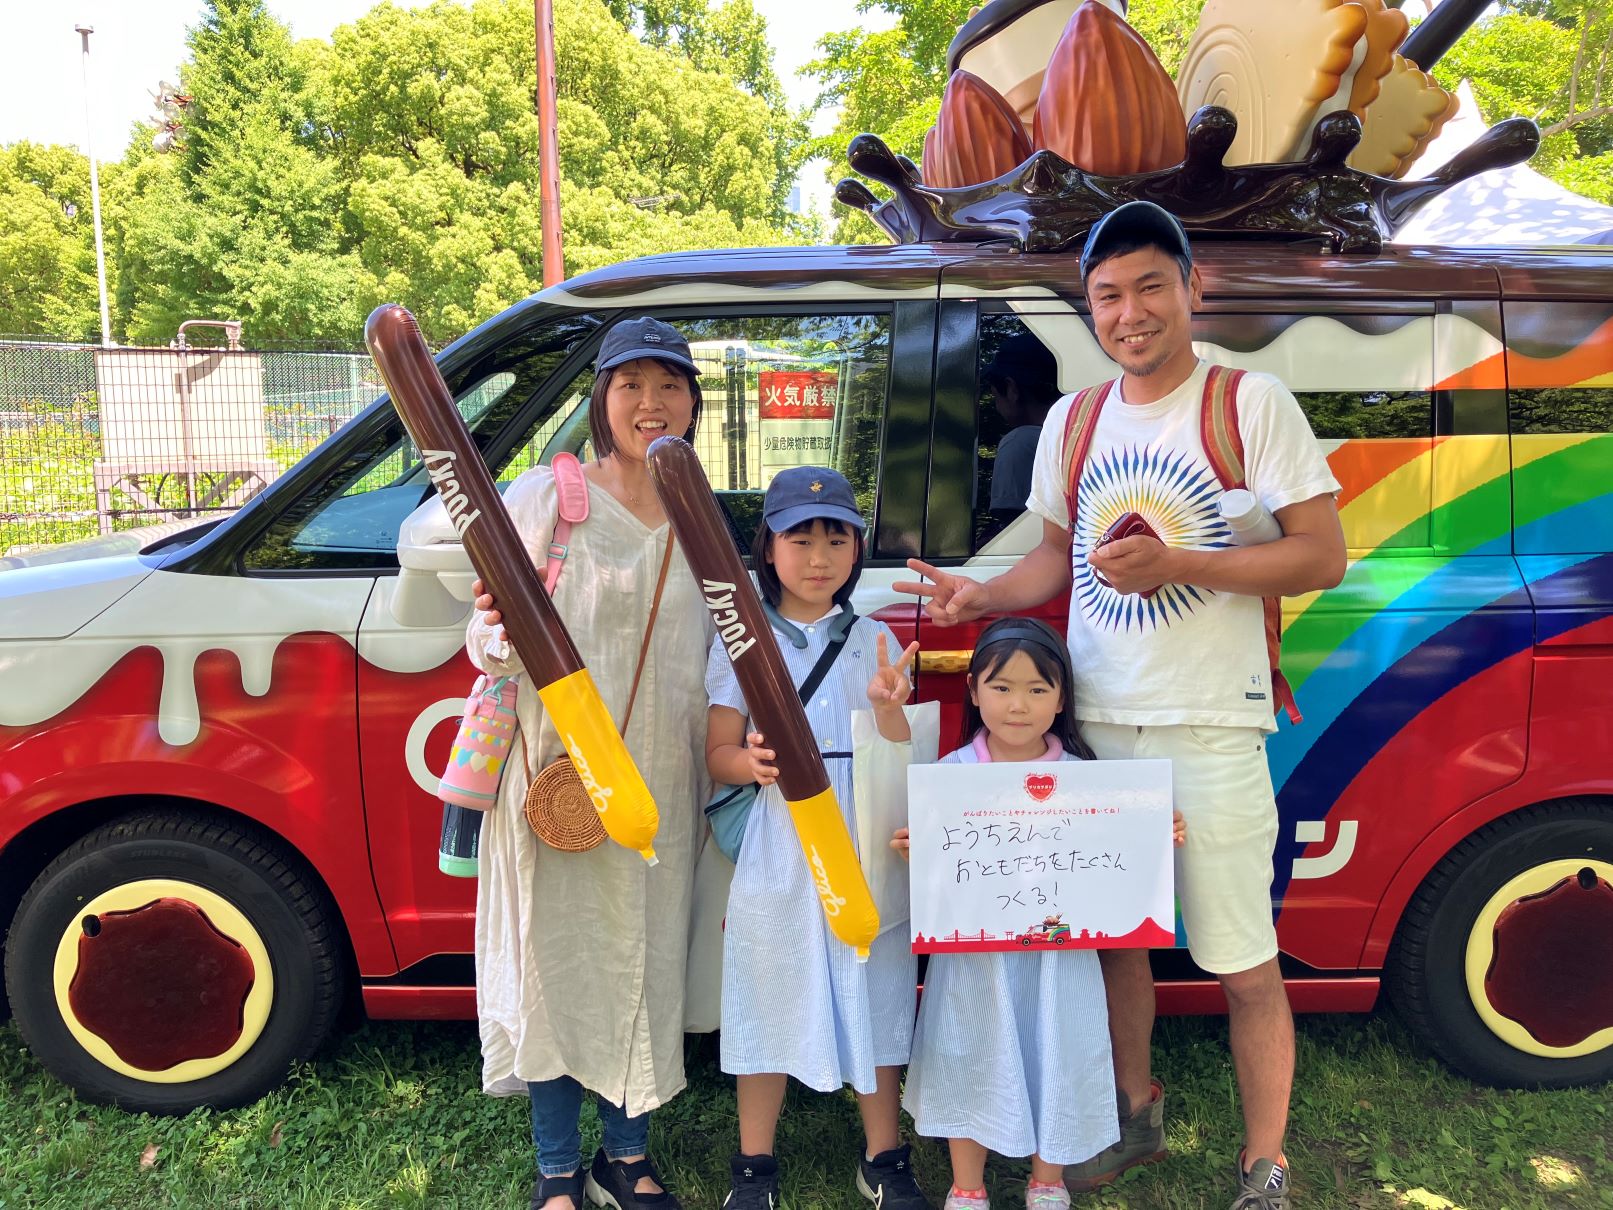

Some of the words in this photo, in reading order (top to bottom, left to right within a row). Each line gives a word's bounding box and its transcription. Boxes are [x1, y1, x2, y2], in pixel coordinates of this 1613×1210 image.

[765, 381, 837, 407] 火気厳禁
[942, 818, 1071, 851] ようちえんで
[956, 849, 1127, 883] おともだちをたくさん
[996, 881, 1058, 911] つくる!
